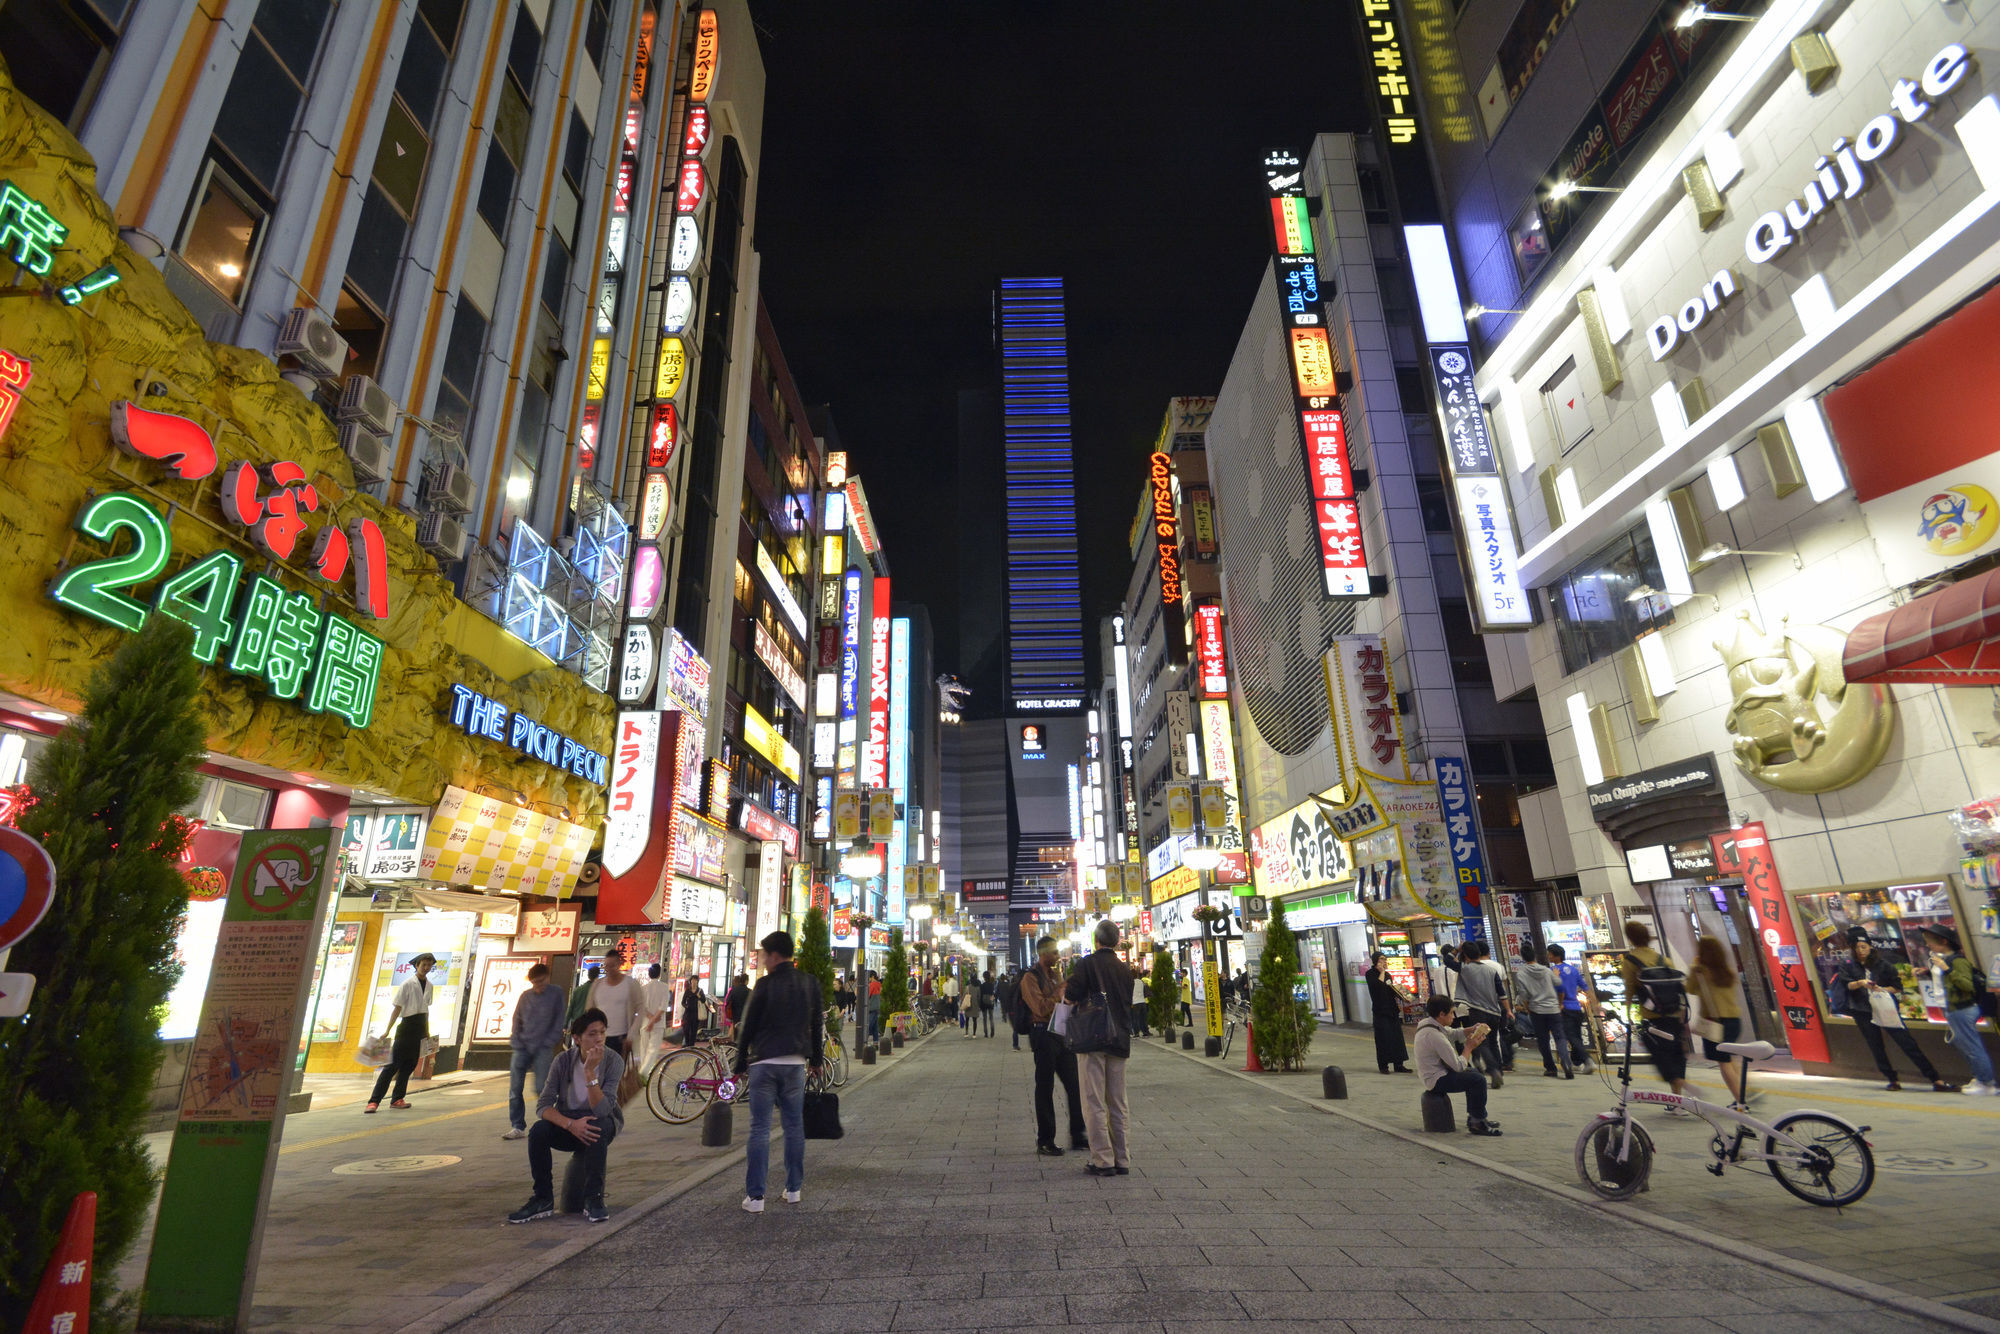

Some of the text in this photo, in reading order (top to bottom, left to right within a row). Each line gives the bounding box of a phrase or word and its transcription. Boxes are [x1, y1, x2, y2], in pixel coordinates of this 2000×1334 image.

[1646, 267, 1742, 363] Don
[1744, 42, 1970, 264] Quijote
[1285, 264, 1319, 313] Elle de Castle
[663, 354, 682, 385] 虎の子
[1309, 397, 1329, 408] 6F
[1317, 436, 1346, 497] 居楽屋
[1151, 451, 1176, 537] Capsule
[111, 401, 389, 619] つぼ八
[1319, 503, 1361, 566] 笑笑
[1476, 503, 1508, 586] 写真スタジオ
[46, 492, 386, 728] 24時間
[1494, 592, 1515, 612] 5F
[624, 687, 639, 696] B1
[870, 617, 890, 789] SHIDAX KARAO
[1016, 699, 1082, 709] HOTEL GRACERY
[1357, 645, 1401, 765] カラオケ
[451, 683, 608, 786] THE PICK PECK
[613, 720, 642, 812] トラノコ
[1590, 793, 1613, 806] Don
[1612, 780, 1655, 800] Quijote
[1381, 802, 1440, 813] KARAOKE 747
[1440, 762, 1477, 863] カラオケ
[1290, 811, 1347, 880] 金の蔵
[370, 860, 416, 875] 虎の子
[1218, 856, 1236, 871] 2F
[1458, 867, 1482, 884] B1
[976, 881, 1006, 890] MARUHAN
[1500, 895, 1513, 918] 探偵
[530, 927, 571, 939] トラノコ
[592, 938, 614, 947] BLD.
[1506, 934, 1521, 957] 探偵
[395, 963, 411, 974] 4F
[1633, 1091, 1683, 1104] PLAYBOY
[51, 1259, 87, 1334] 新宿
